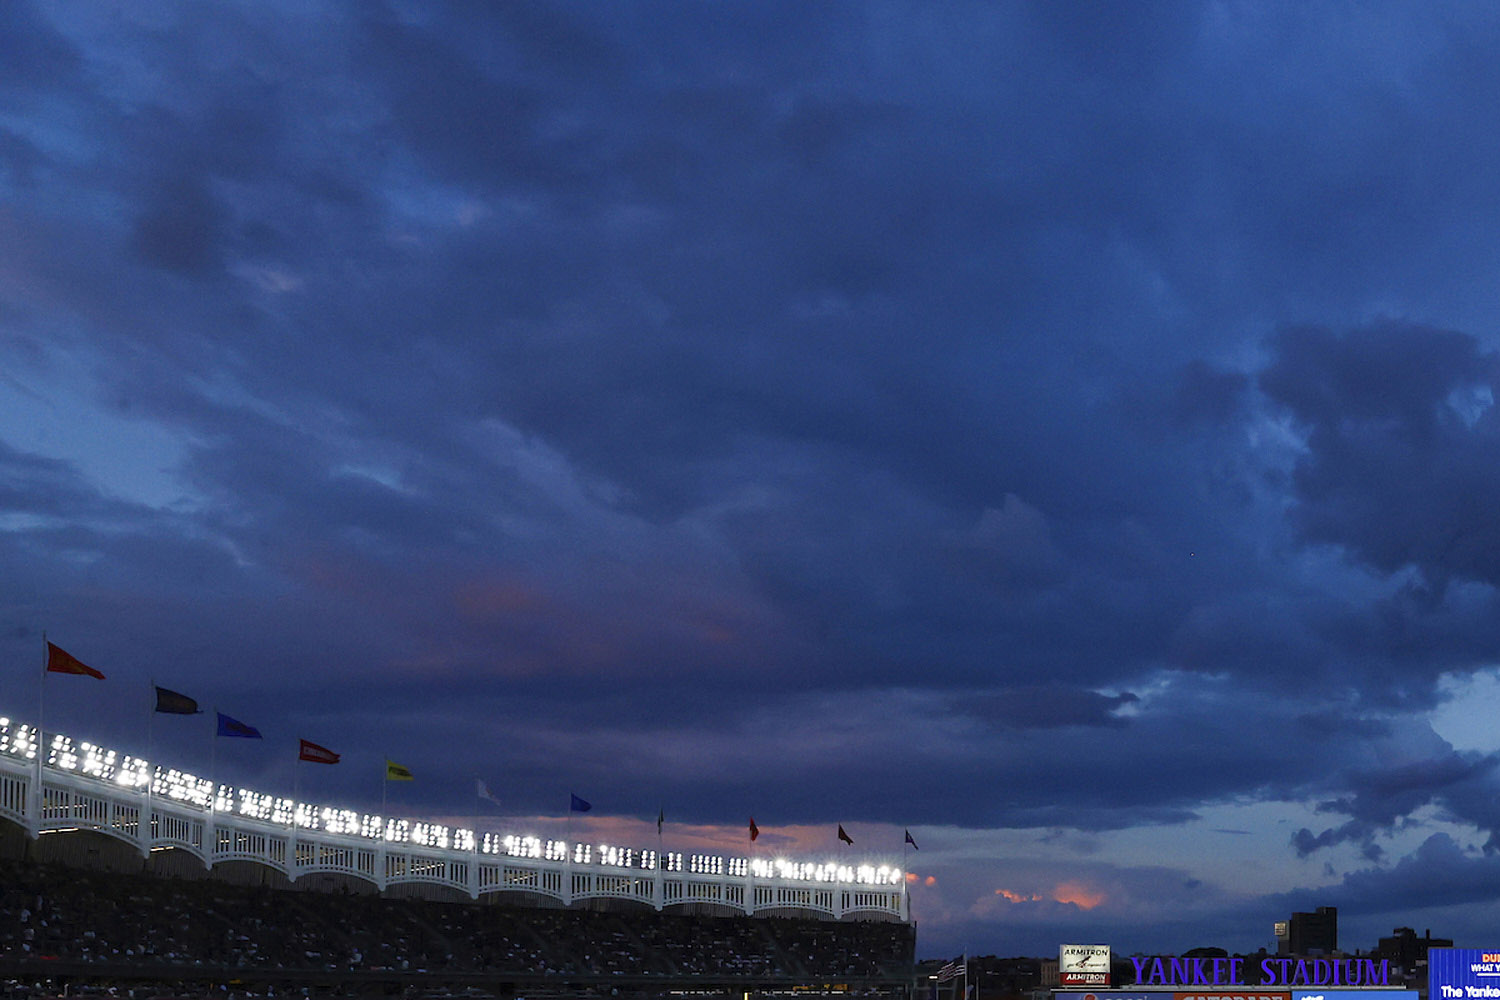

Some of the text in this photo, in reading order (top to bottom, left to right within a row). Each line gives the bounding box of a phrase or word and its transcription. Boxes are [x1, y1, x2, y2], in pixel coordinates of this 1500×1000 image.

[1130, 956, 1390, 986] YANKEE STADIUM
[1471, 964, 1494, 972] WHAT
[1441, 985, 1463, 998] The
